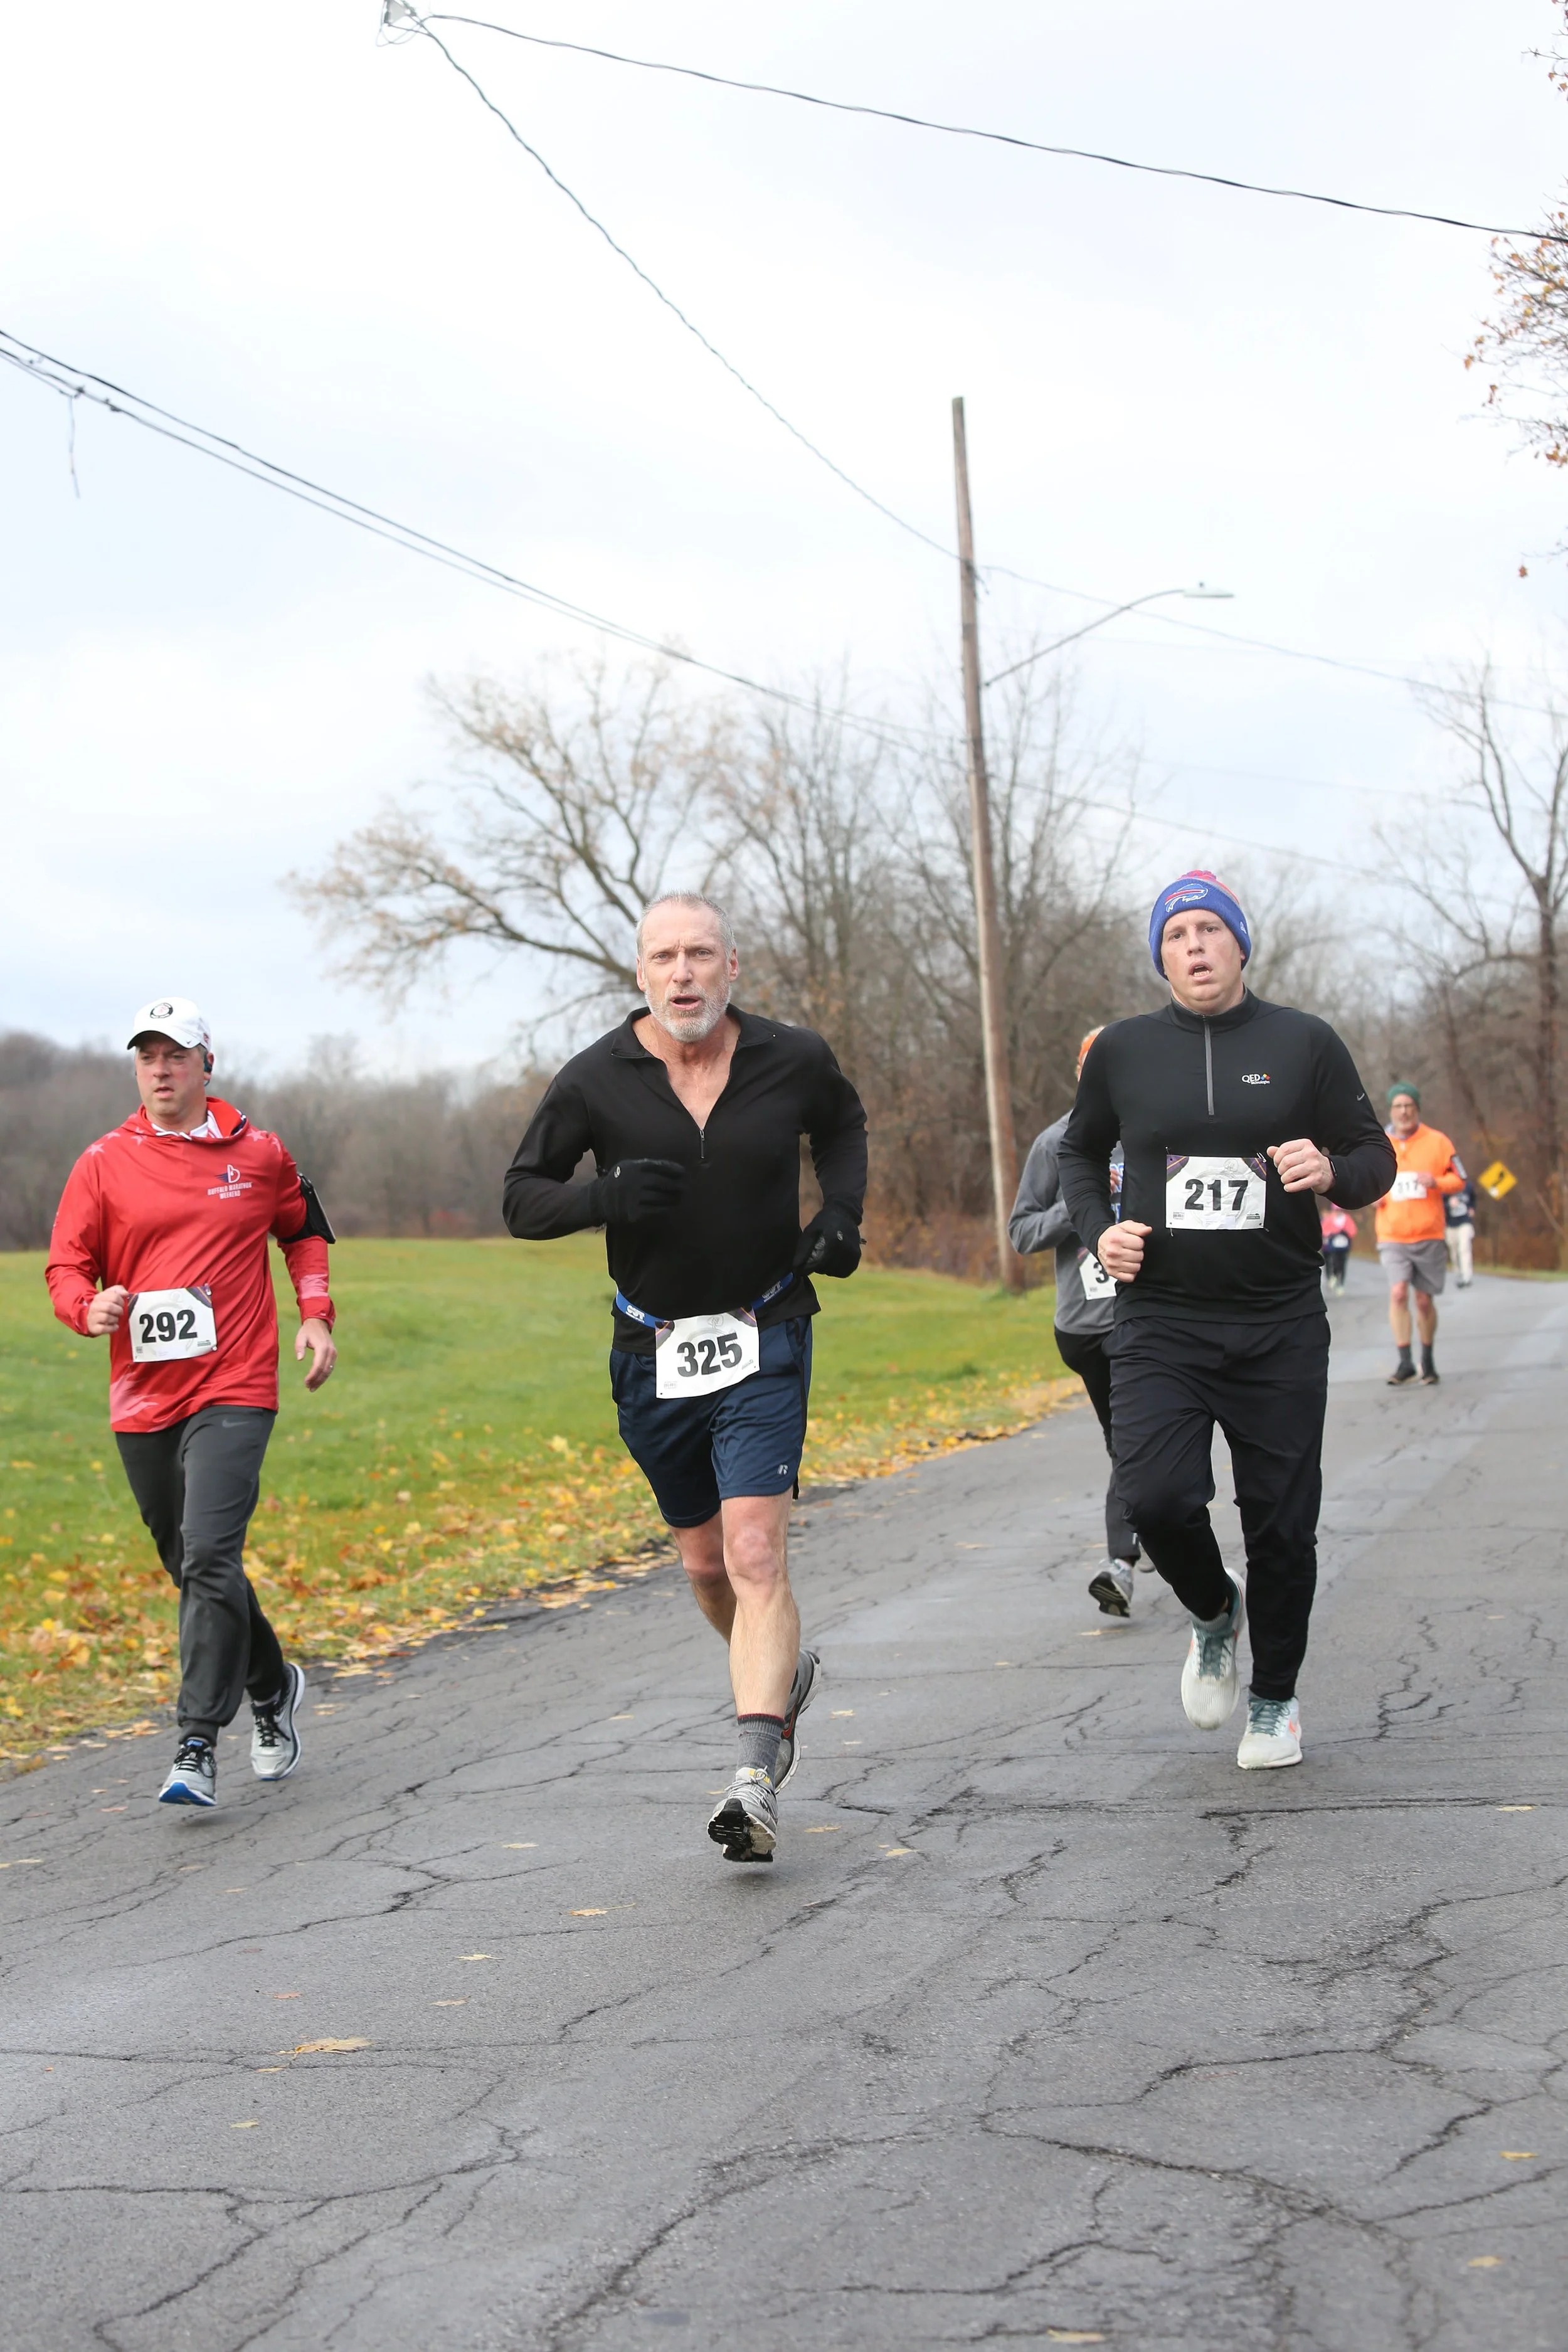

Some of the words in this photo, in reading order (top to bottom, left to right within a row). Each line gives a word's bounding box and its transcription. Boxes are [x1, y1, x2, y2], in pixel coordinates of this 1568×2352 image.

[1241, 1074, 1261, 1084] QED
[219, 1190, 241, 1200] WEEKEND
[1185, 1179, 1249, 1211] 217
[139, 1309, 198, 1344] 292
[677, 1332, 743, 1378] 325
